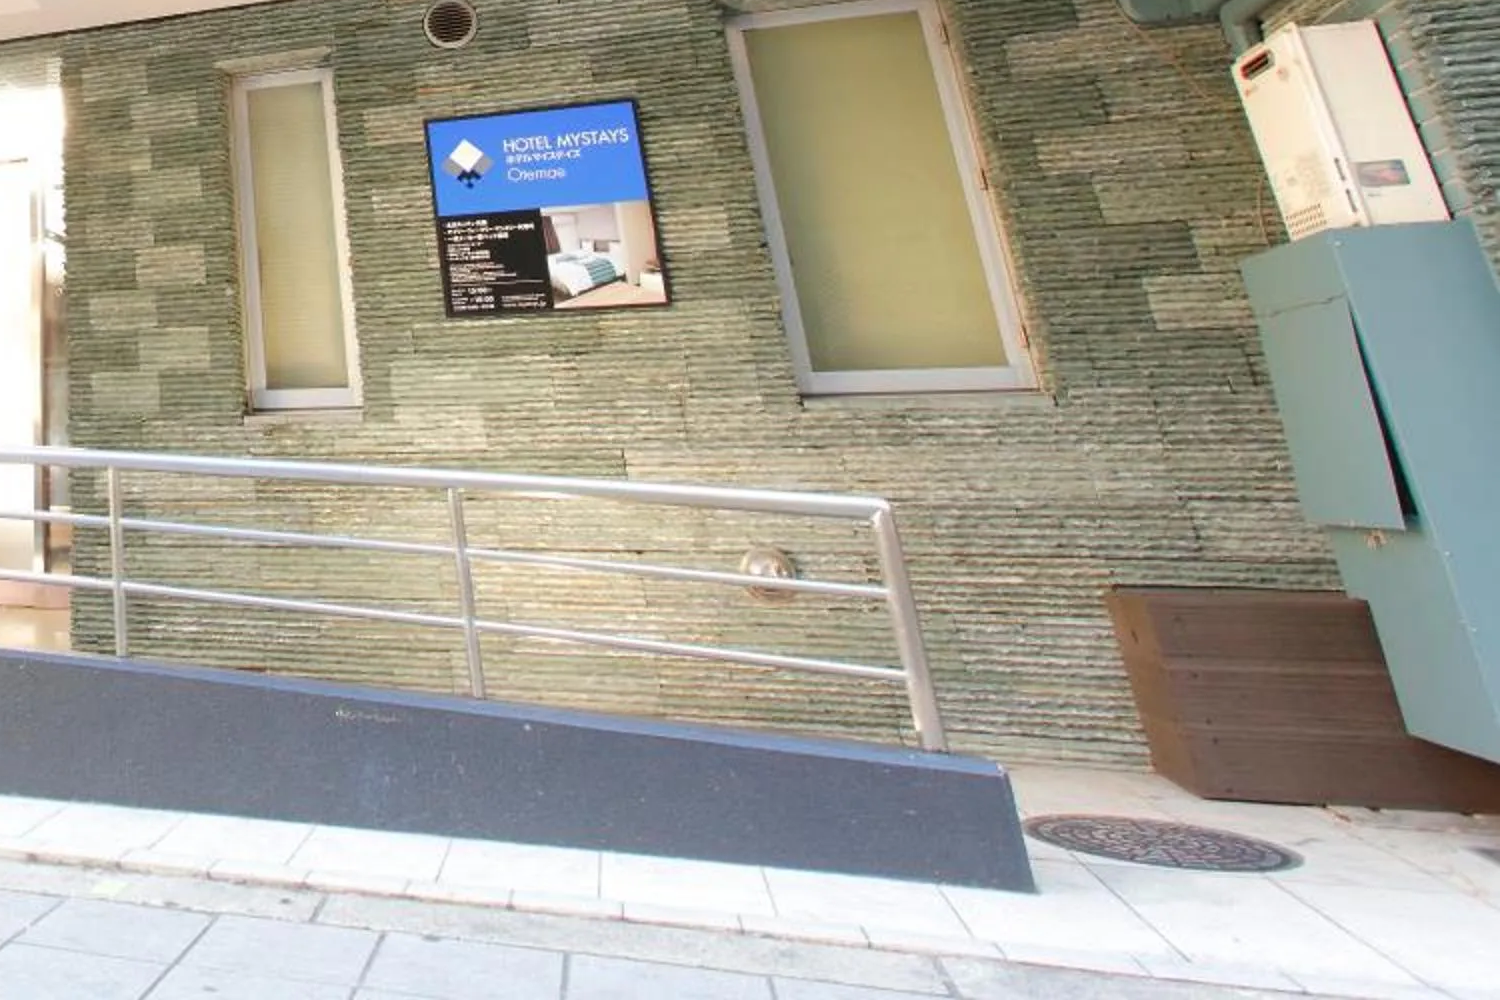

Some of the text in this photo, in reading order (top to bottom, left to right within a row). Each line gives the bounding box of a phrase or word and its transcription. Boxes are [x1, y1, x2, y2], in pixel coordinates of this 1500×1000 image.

[502, 127, 630, 154] HOTEL MYSTAYS
[507, 166, 566, 182] Otemae
